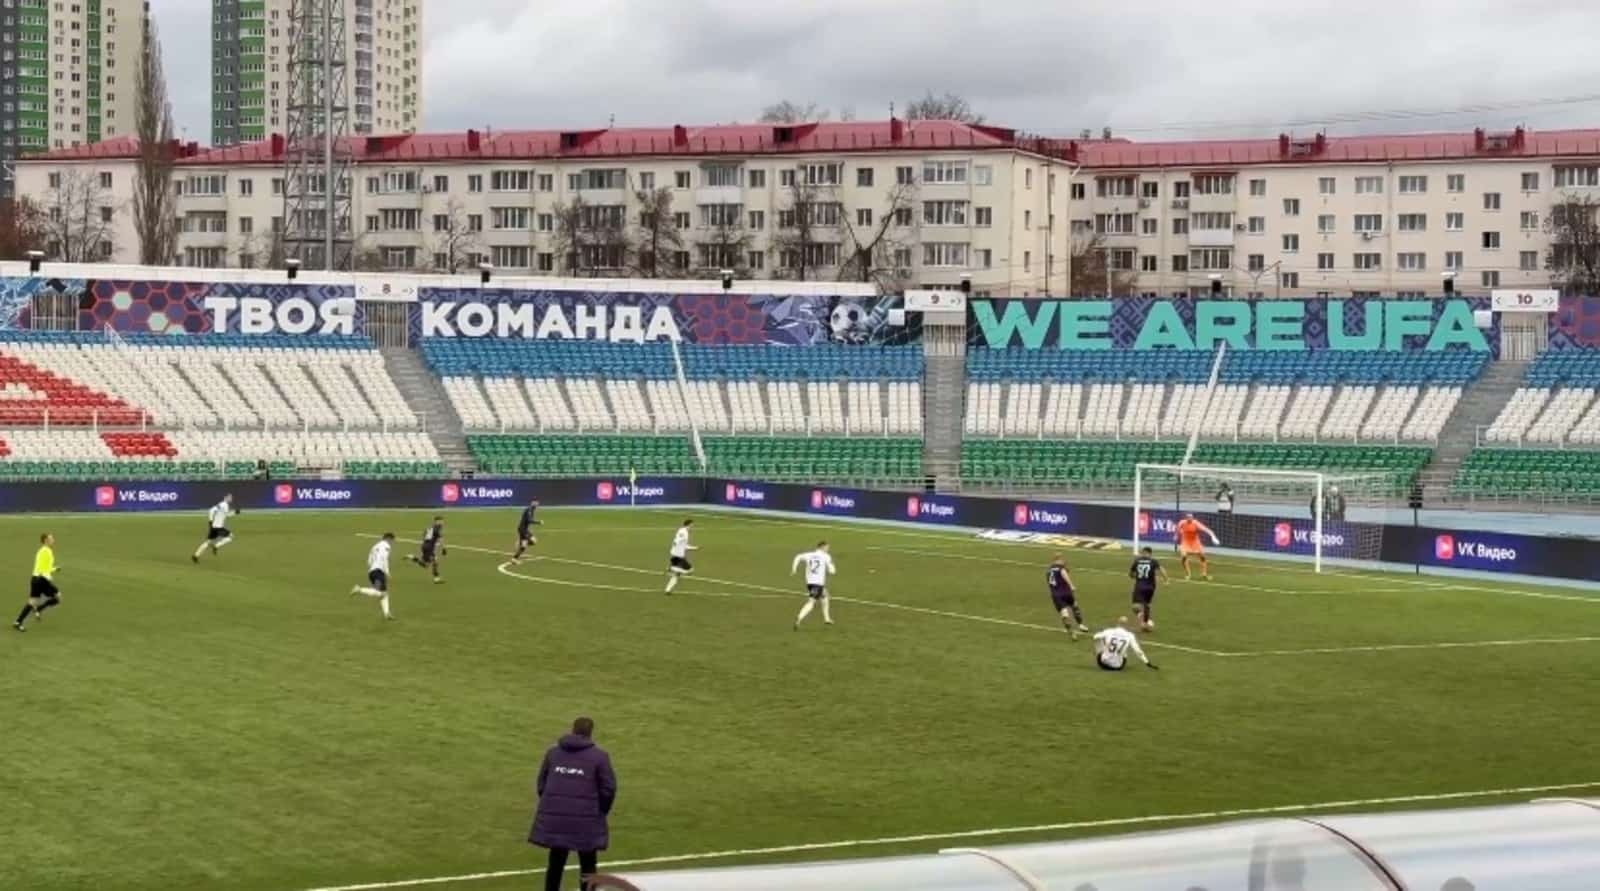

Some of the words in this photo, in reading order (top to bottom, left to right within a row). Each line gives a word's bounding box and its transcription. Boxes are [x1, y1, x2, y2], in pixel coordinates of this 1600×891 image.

[382, 283, 392, 295] 8
[931, 294, 940, 305] 9
[1517, 293, 1533, 304] 10
[204, 297, 356, 335] ТВОЯ
[422, 301, 682, 343] КОМАНДА
[971, 300, 1113, 349] WE
[1133, 300, 1304, 350] ARE
[1327, 300, 1492, 351] UFA
[119, 490, 137, 502] VK
[138, 490, 177, 504] Видео
[296, 487, 313, 500] VK
[314, 488, 351, 502] Видео
[462, 487, 478, 498] VK
[479, 488, 513, 500] Видео
[615, 485, 631, 495] VK
[1029, 508, 1041, 522] VK
[1458, 543, 1474, 557] VK
[1477, 543, 1516, 561] Видео
[1108, 637, 1126, 654] 57
